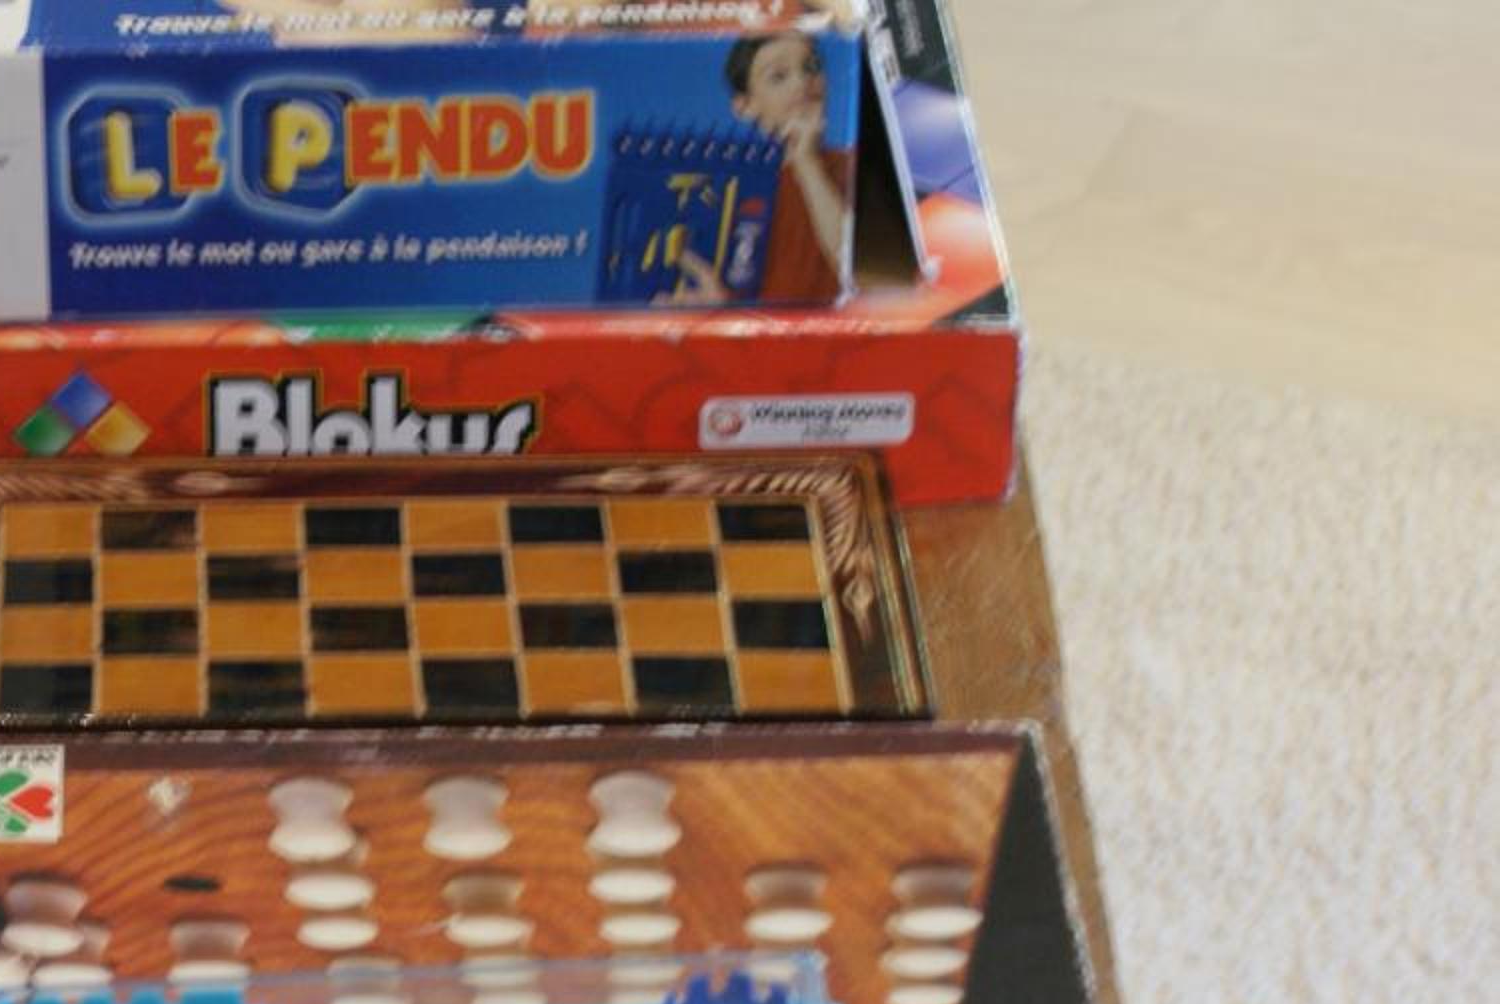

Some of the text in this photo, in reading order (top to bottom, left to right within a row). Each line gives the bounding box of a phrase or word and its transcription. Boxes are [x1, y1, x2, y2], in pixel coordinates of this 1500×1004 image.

[106, 89, 594, 202] LE PENDU
[68, 240, 162, 270] Trouve
[166, 239, 194, 266] le
[200, 239, 253, 265] mot
[259, 240, 296, 265] ou
[301, 237, 364, 269] gare
[393, 233, 421, 261] la
[426, 228, 569, 264] pendaison
[212, 374, 536, 457] Blokus
